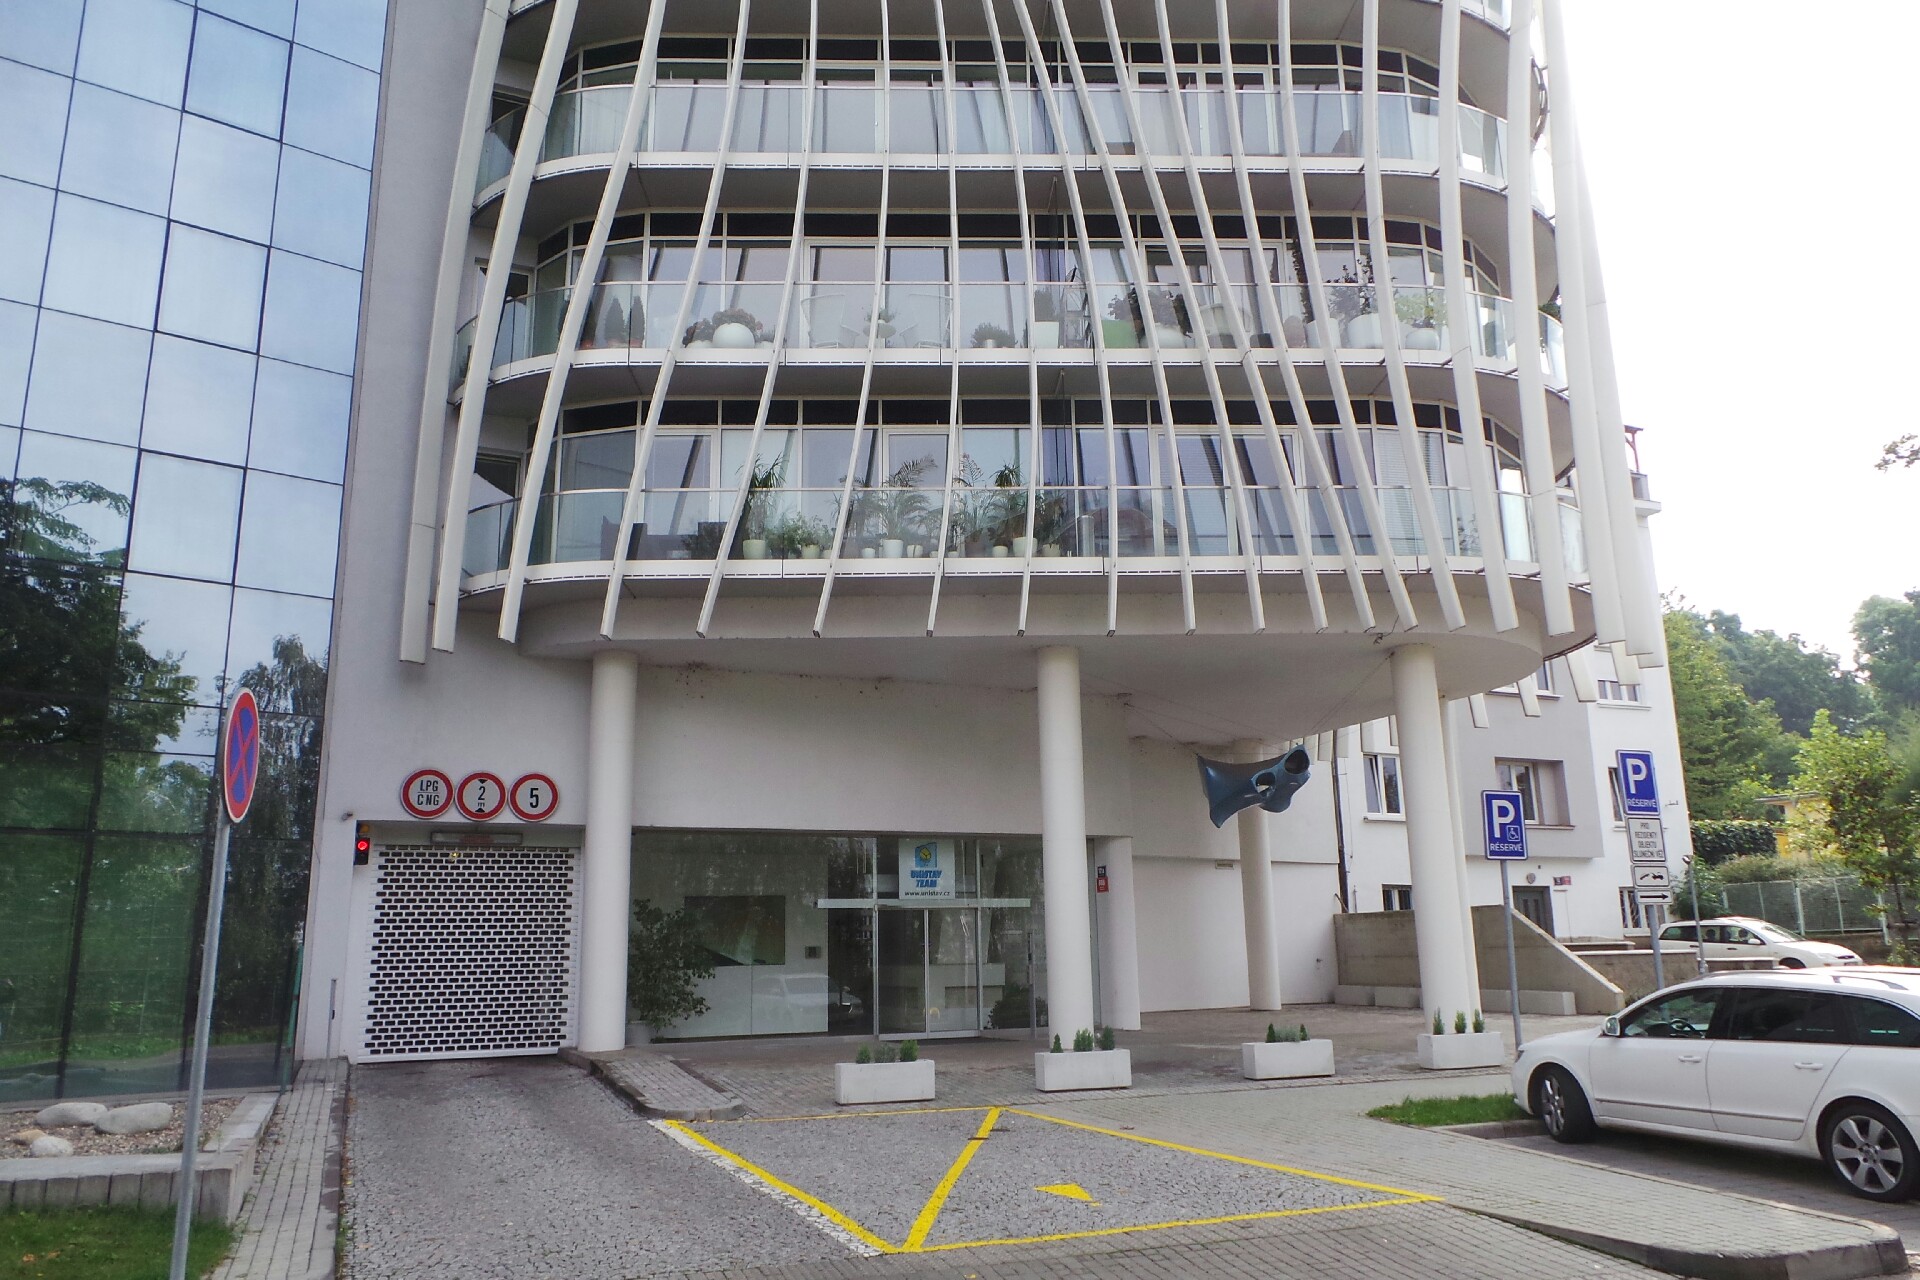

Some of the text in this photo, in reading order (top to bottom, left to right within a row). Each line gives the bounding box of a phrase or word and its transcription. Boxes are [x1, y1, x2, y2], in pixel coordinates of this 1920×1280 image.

[1626, 758, 1647, 794] P
[419, 780, 439, 791] LPG
[417, 794, 439, 805] CNG
[478, 786, 486, 800] 2
[530, 788, 539, 808] 5
[1491, 800, 1516, 838] P
[916, 879, 937, 887] TEAM
